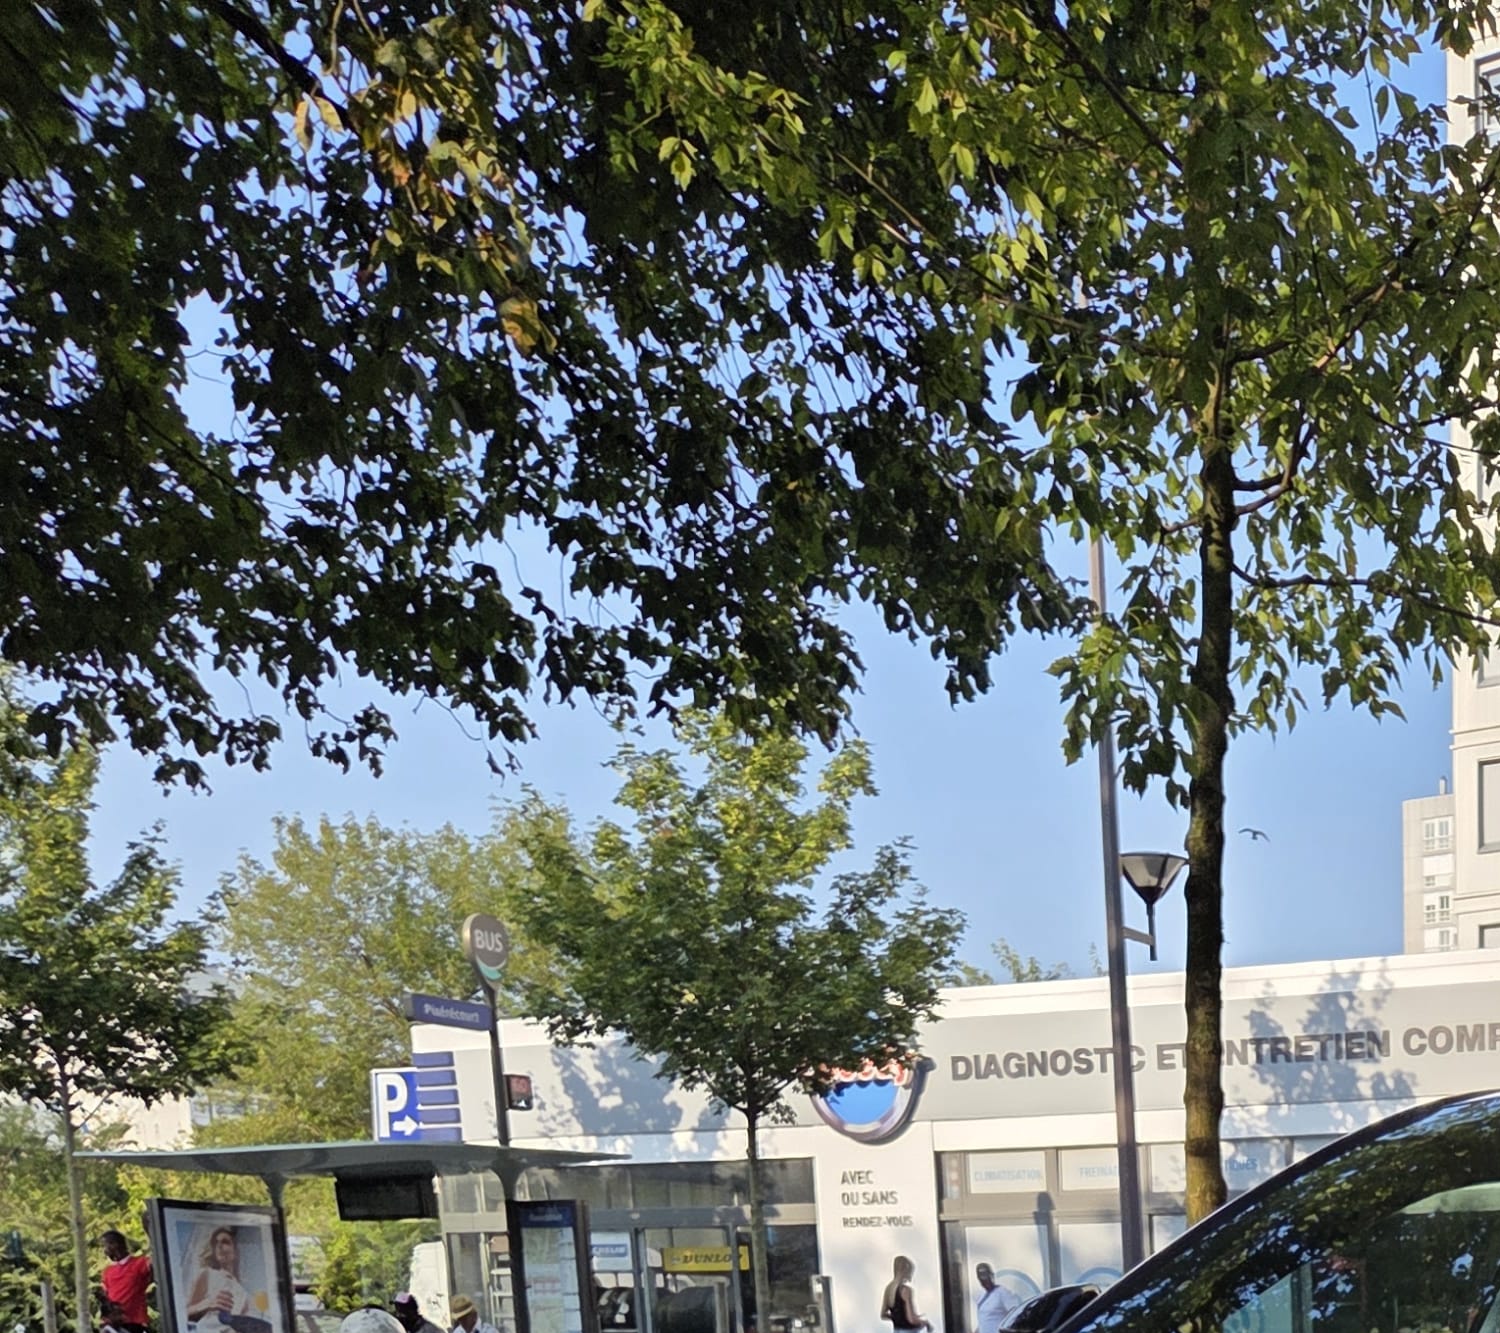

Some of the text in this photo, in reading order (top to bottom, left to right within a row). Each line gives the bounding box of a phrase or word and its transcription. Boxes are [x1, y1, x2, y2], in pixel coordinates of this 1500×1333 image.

[474, 929, 503, 952] BUS
[950, 1045, 1146, 1081] DIAGNOSTC
[1222, 1030, 1390, 1066] NTRETIEN
[376, 1073, 408, 1138] P
[840, 1170, 874, 1186] AVEC
[841, 1190, 898, 1206] OU SANS
[842, 1215, 913, 1228] RENDEZ-VOUS
